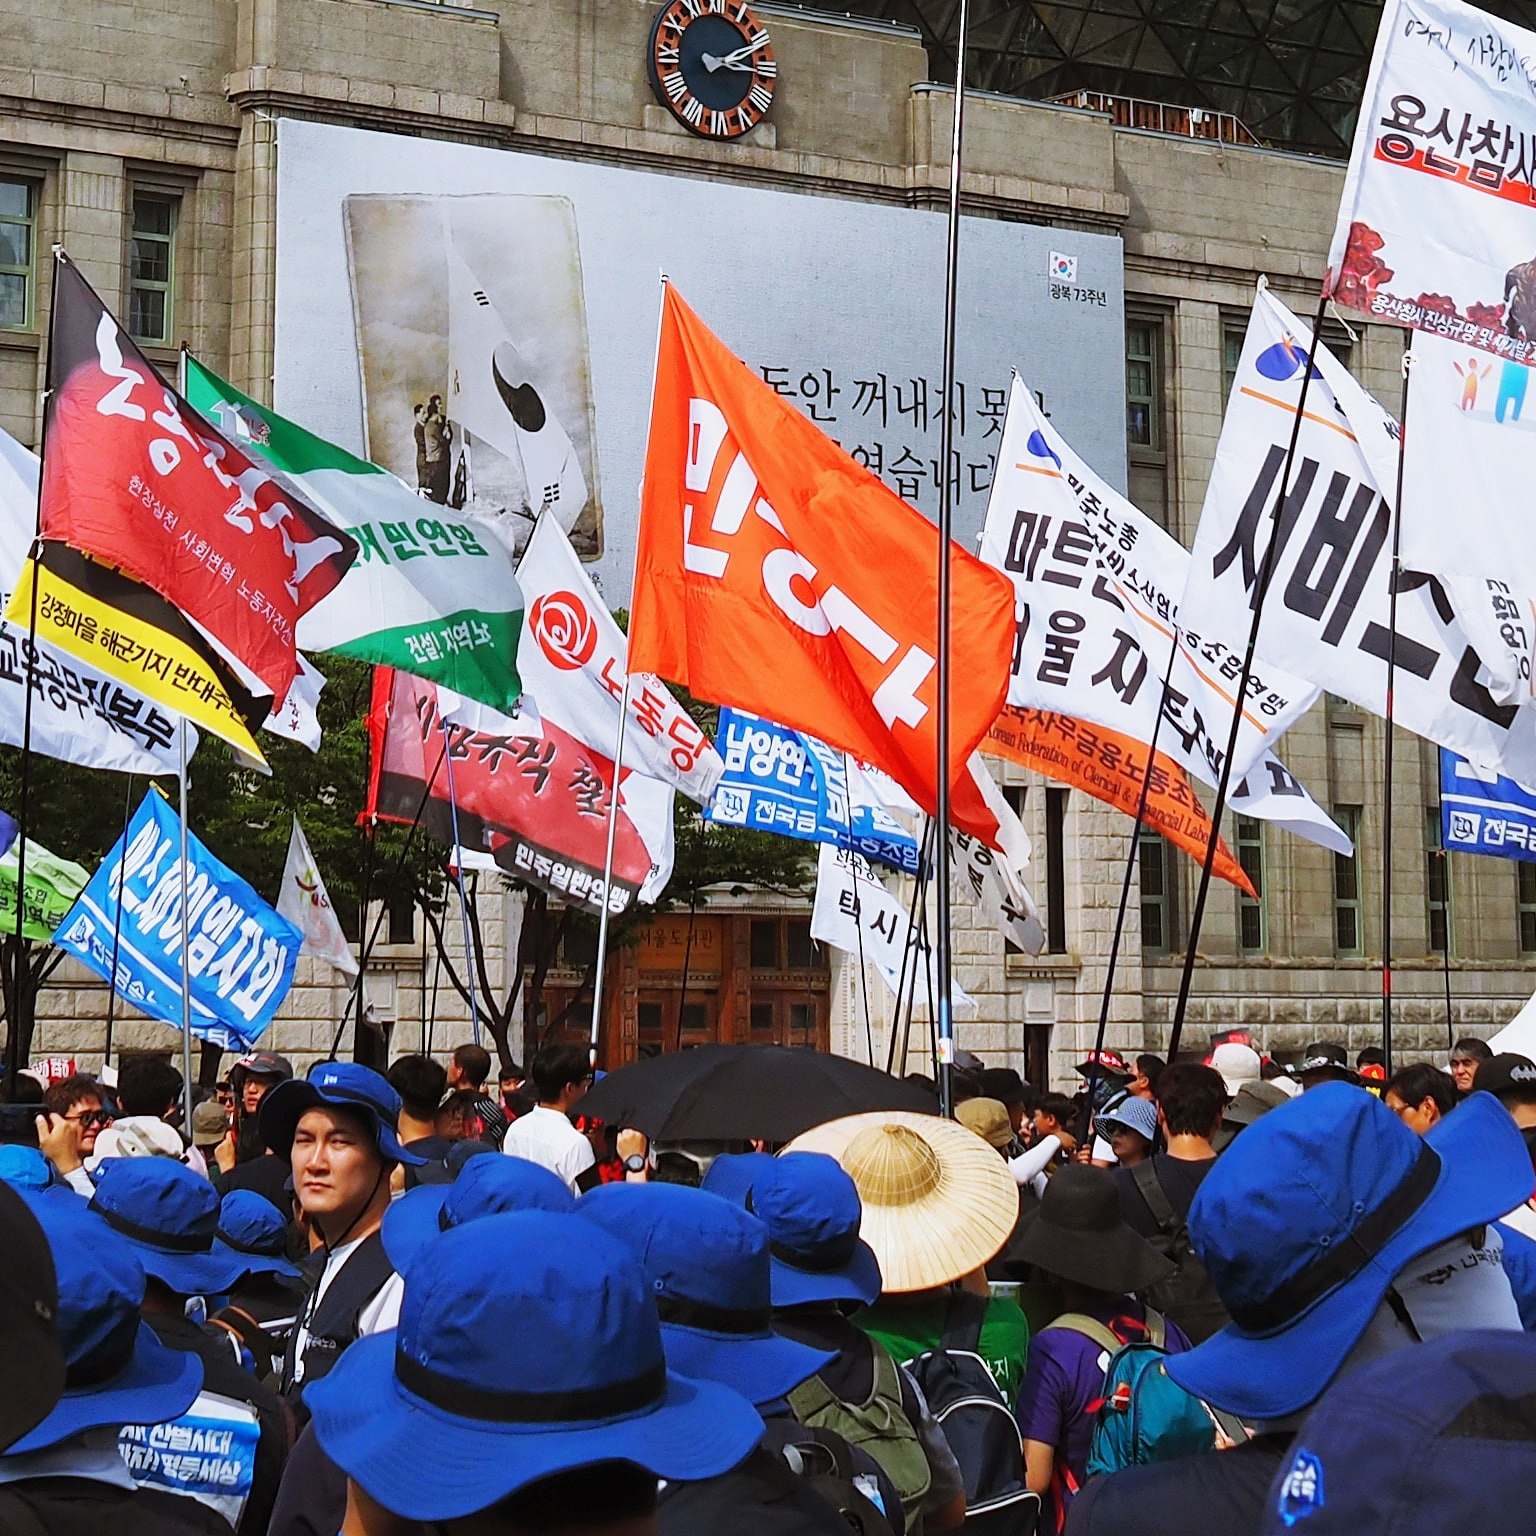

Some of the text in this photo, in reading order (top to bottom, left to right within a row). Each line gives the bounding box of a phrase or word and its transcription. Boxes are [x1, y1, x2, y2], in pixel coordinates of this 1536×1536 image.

[1073, 288, 1107, 307] 73주년
[851, 372, 967, 438] 꺼내지
[178, 530, 237, 585] 사회변혁
[39, 591, 99, 640] 강정마을
[100, 627, 172, 682] 해군기지
[600, 655, 714, 773] 노동당
[999, 701, 1210, 822] 국사무금융노동조합
[1016, 732, 1070, 769] Federation
[1069, 758, 1083, 778] of
